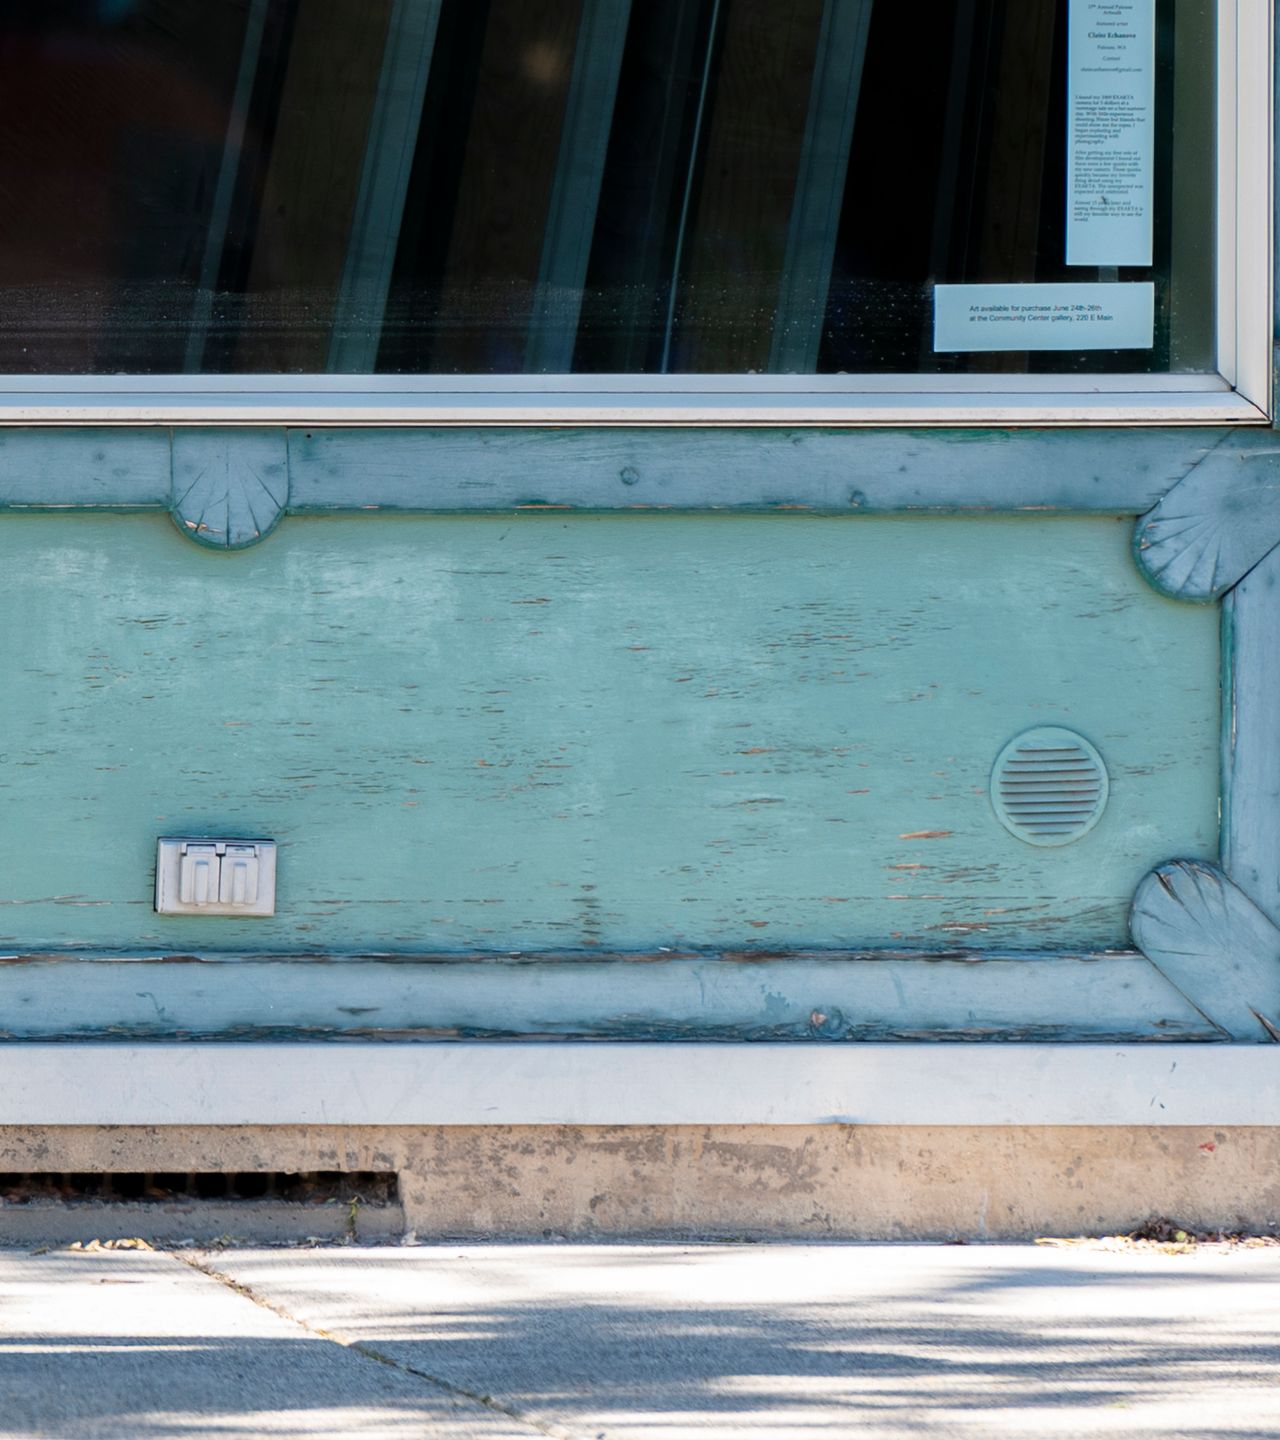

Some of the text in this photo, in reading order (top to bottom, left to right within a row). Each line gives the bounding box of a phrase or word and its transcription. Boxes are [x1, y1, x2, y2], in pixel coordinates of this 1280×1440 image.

[1087, 31, 1137, 39] Claire Echanove
[969, 304, 979, 312] Art
[980, 304, 1009, 312] available
[1011, 304, 1020, 312] for
[1021, 304, 1051, 314] purchase
[1053, 304, 1069, 312] June
[977, 314, 988, 322] the
[989, 314, 1026, 323] Community
[1028, 314, 1049, 322] Center
[1076, 314, 1088, 322] 220
[1097, 314, 1114, 322] Main
